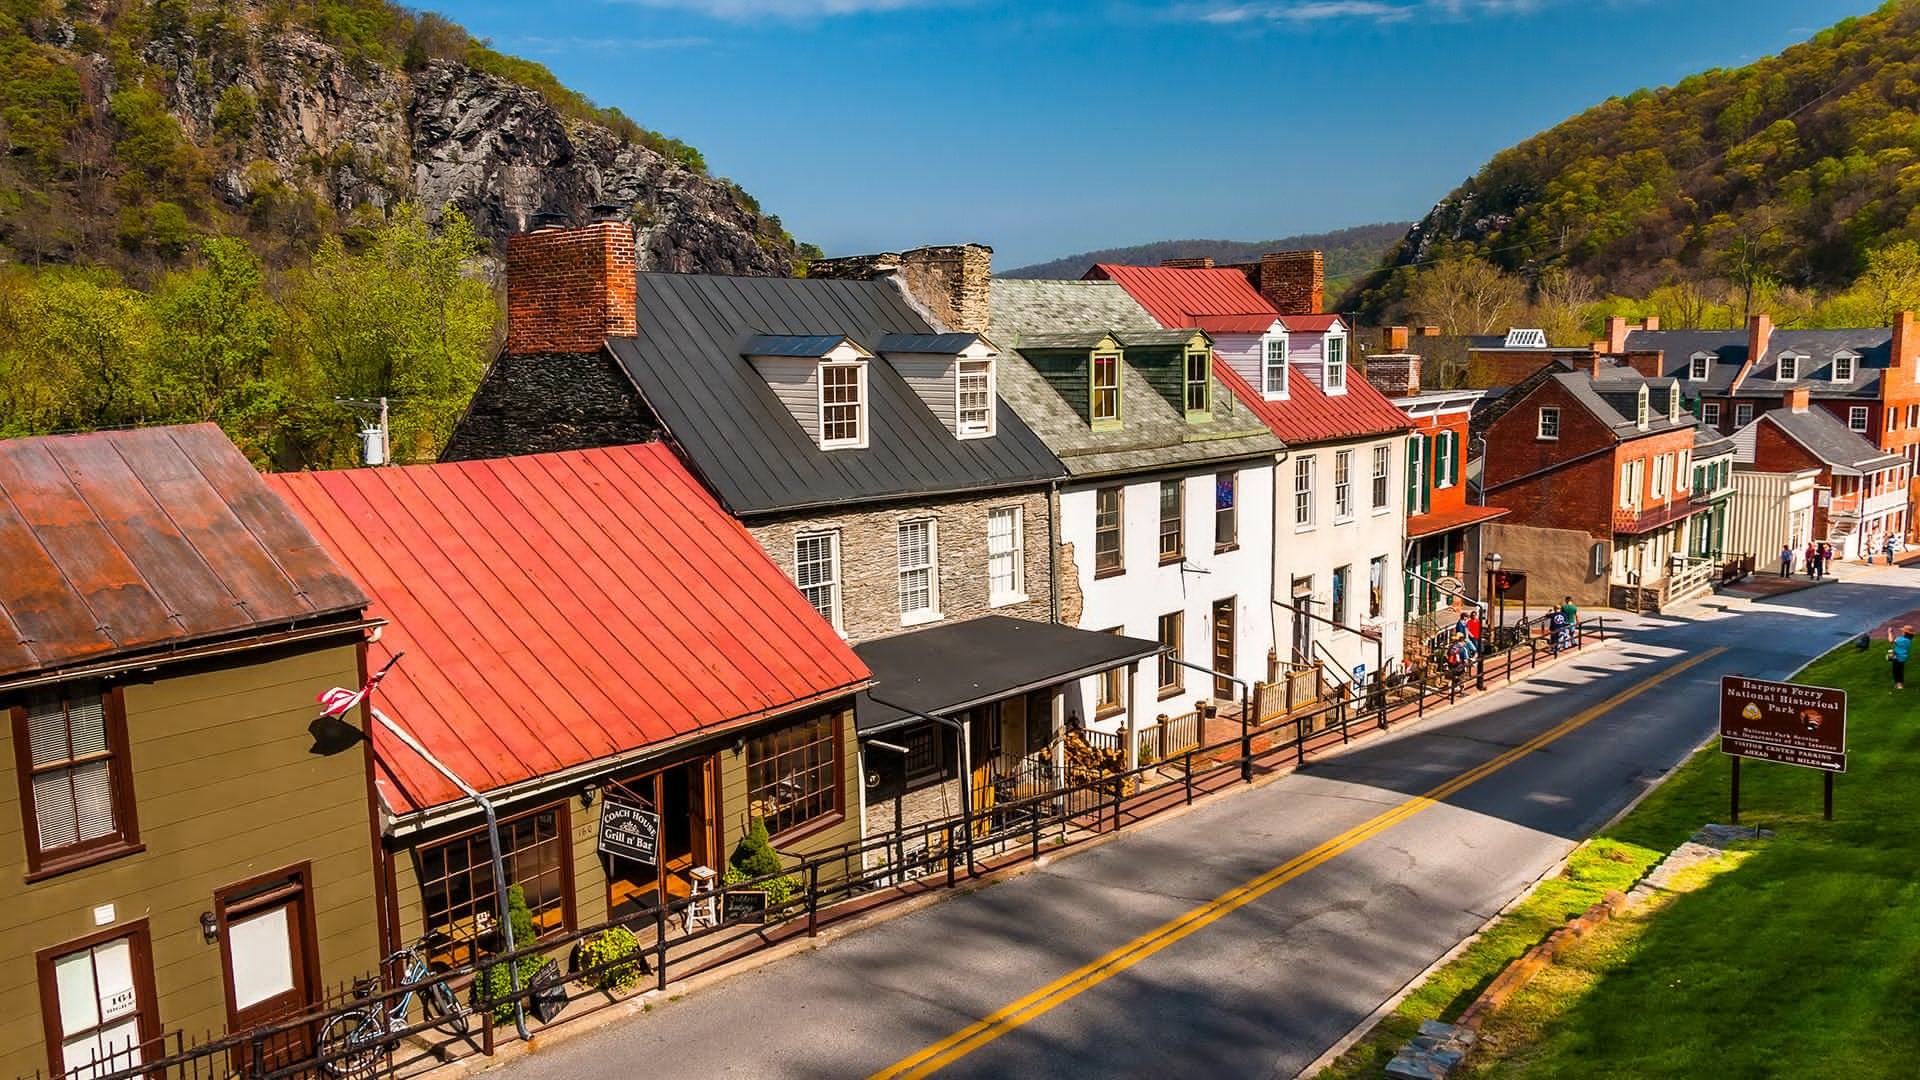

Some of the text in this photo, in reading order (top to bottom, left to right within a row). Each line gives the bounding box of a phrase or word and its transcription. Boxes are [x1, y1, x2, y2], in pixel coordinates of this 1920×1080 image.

[1727, 687, 1839, 710] National Historical
[1743, 681, 1823, 700] Harpers Ferry
[1768, 703, 1796, 715] Park
[1734, 740, 1832, 761] VISITOR CENTER PARKING
[1797, 757, 1821, 766] MILES
[604, 809, 657, 837] COACH HOUSE
[604, 829, 625, 842] Grill
[636, 837, 653, 850] Bar
